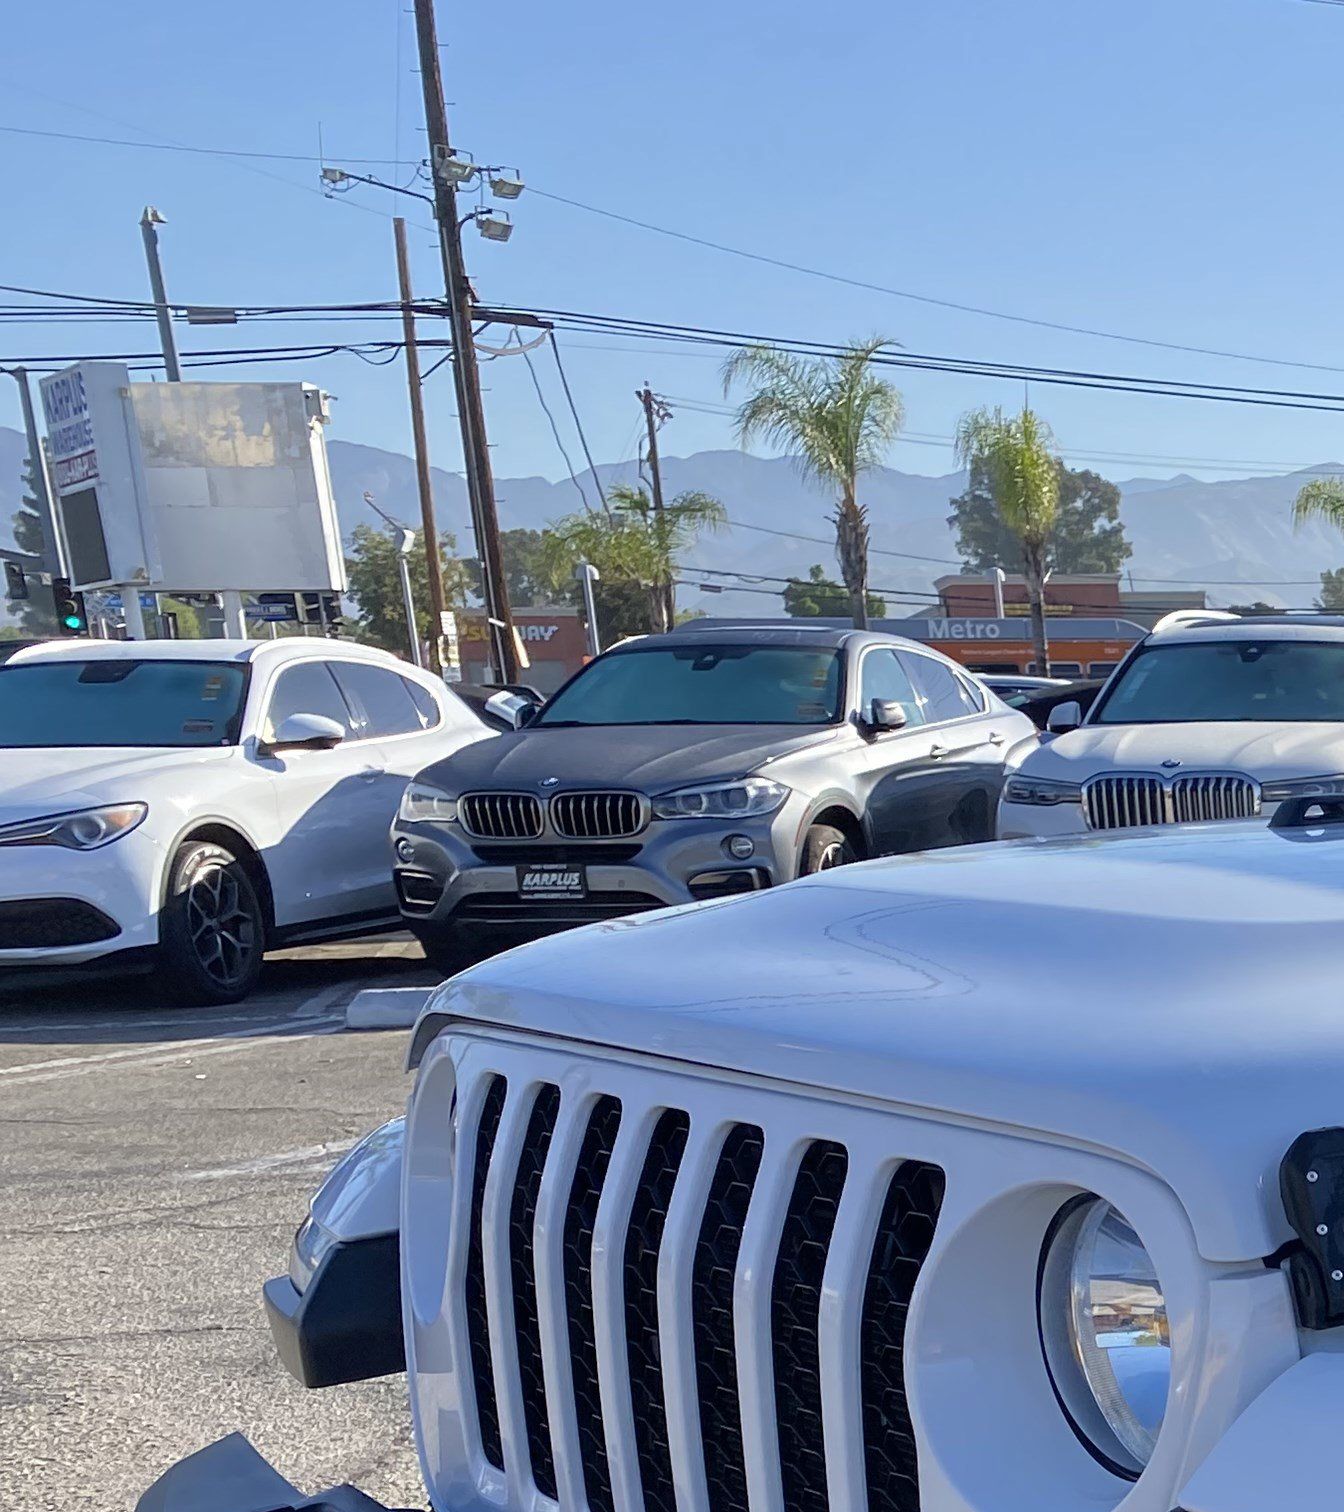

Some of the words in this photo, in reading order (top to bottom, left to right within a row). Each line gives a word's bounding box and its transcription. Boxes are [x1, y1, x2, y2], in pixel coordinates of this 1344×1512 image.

[466, 625, 559, 641] SUAY
[928, 619, 1000, 639] Metro
[523, 872, 581, 886] KARPLUS
